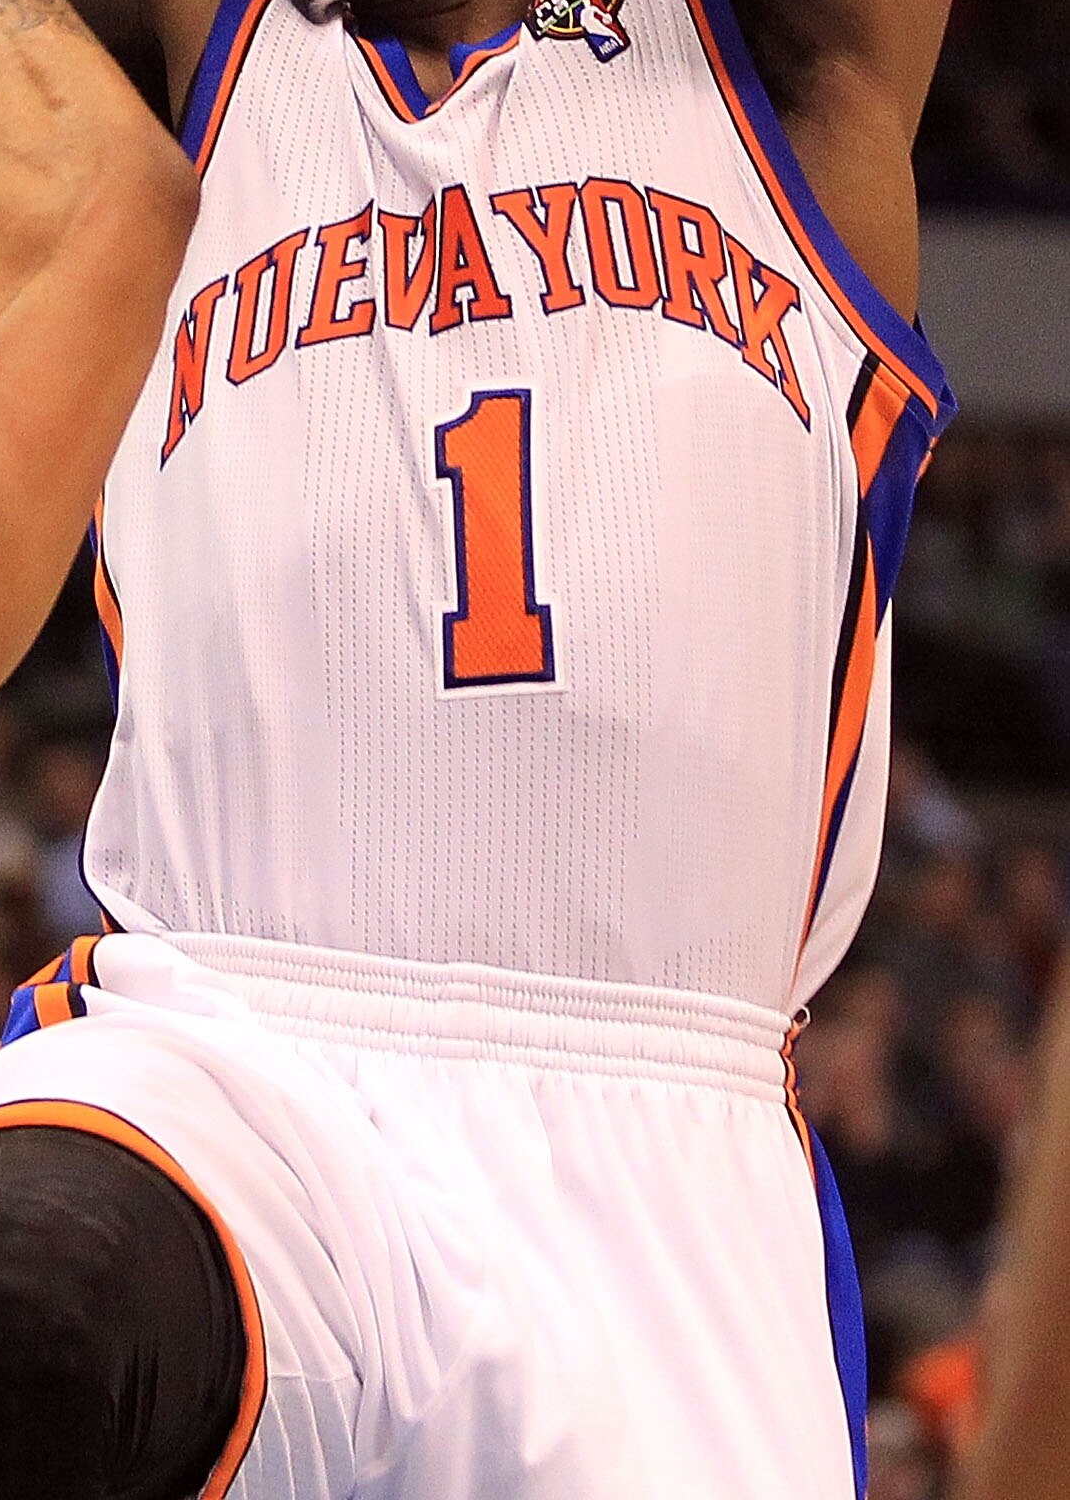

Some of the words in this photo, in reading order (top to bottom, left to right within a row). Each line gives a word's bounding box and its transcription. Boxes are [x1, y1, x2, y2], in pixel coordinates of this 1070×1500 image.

[160, 183, 513, 472] NUEVA
[489, 176, 811, 434] YORK
[433, 388, 557, 691] 1
